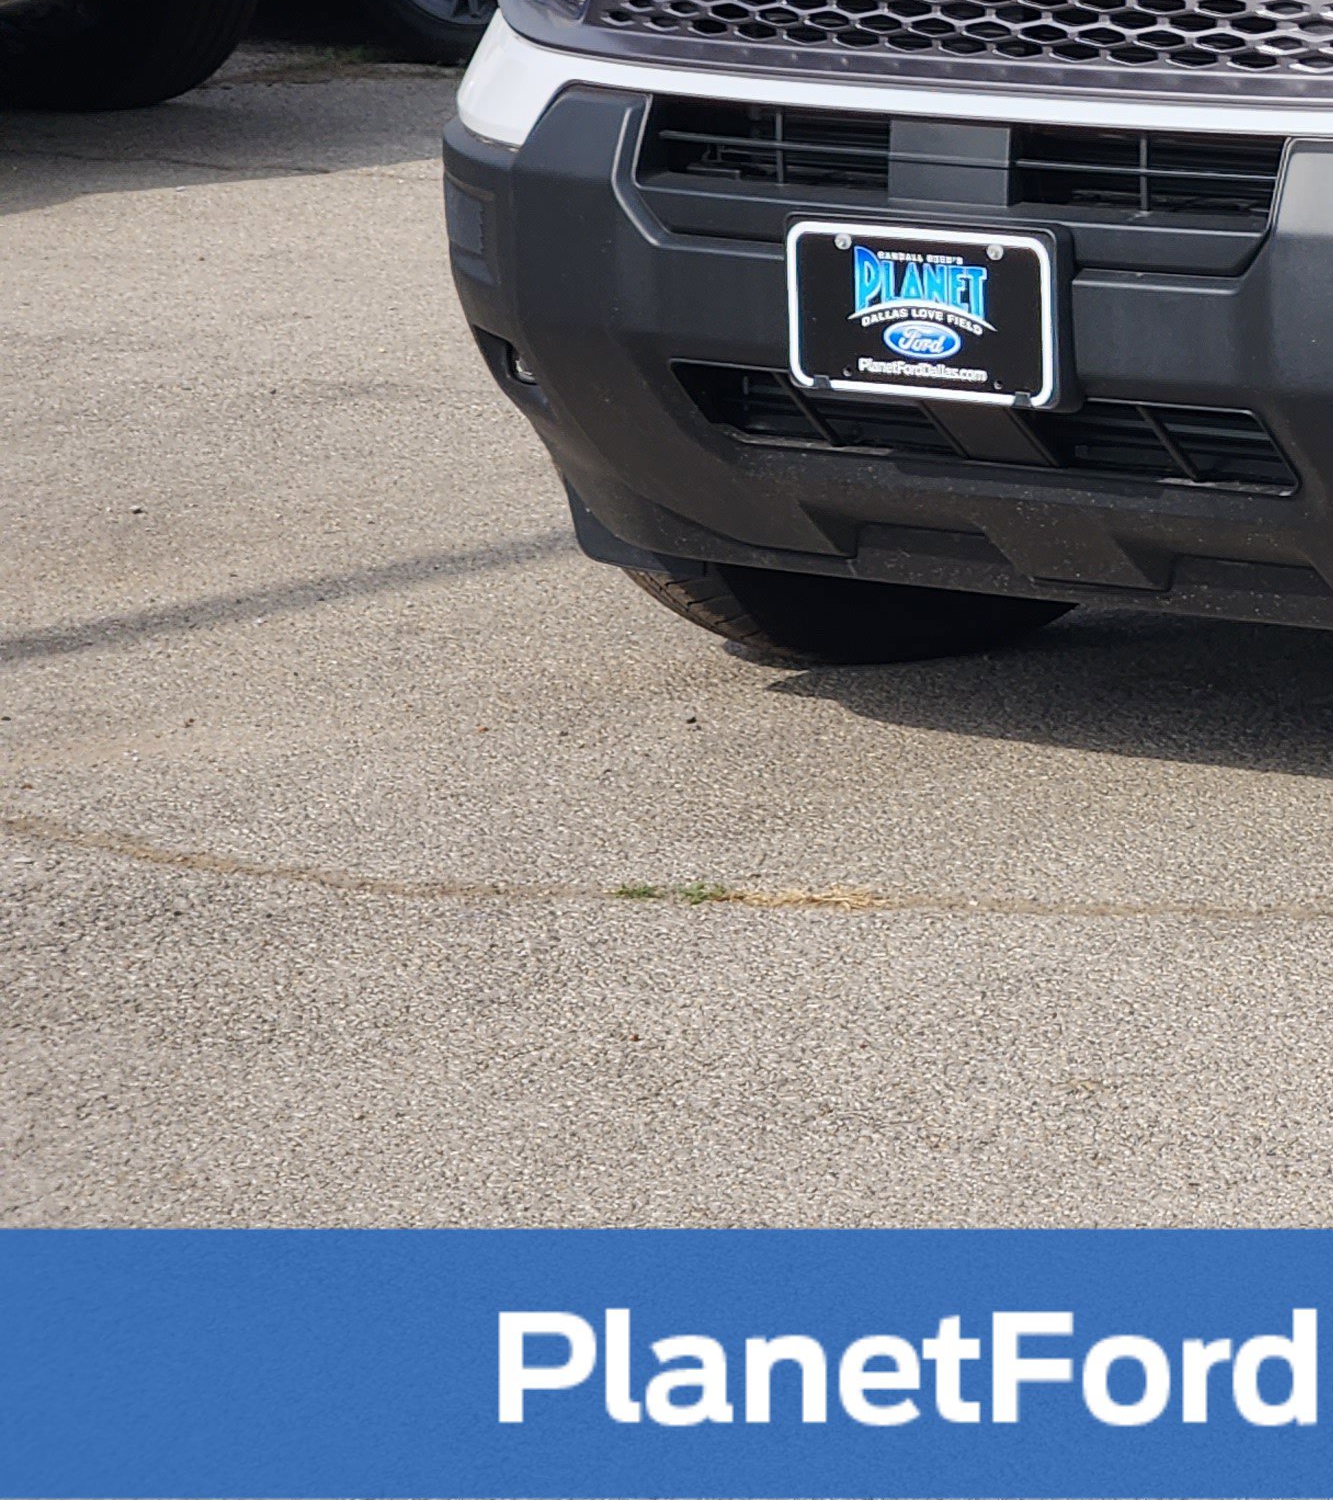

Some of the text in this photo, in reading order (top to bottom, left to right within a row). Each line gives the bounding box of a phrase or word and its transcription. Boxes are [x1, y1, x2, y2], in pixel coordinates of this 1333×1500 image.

[853, 245, 988, 320] PLANET
[861, 307, 983, 336] DALLAS LOVE FIELD
[898, 326, 945, 353] Ford
[857, 357, 989, 383] PlanetFordDallas.com
